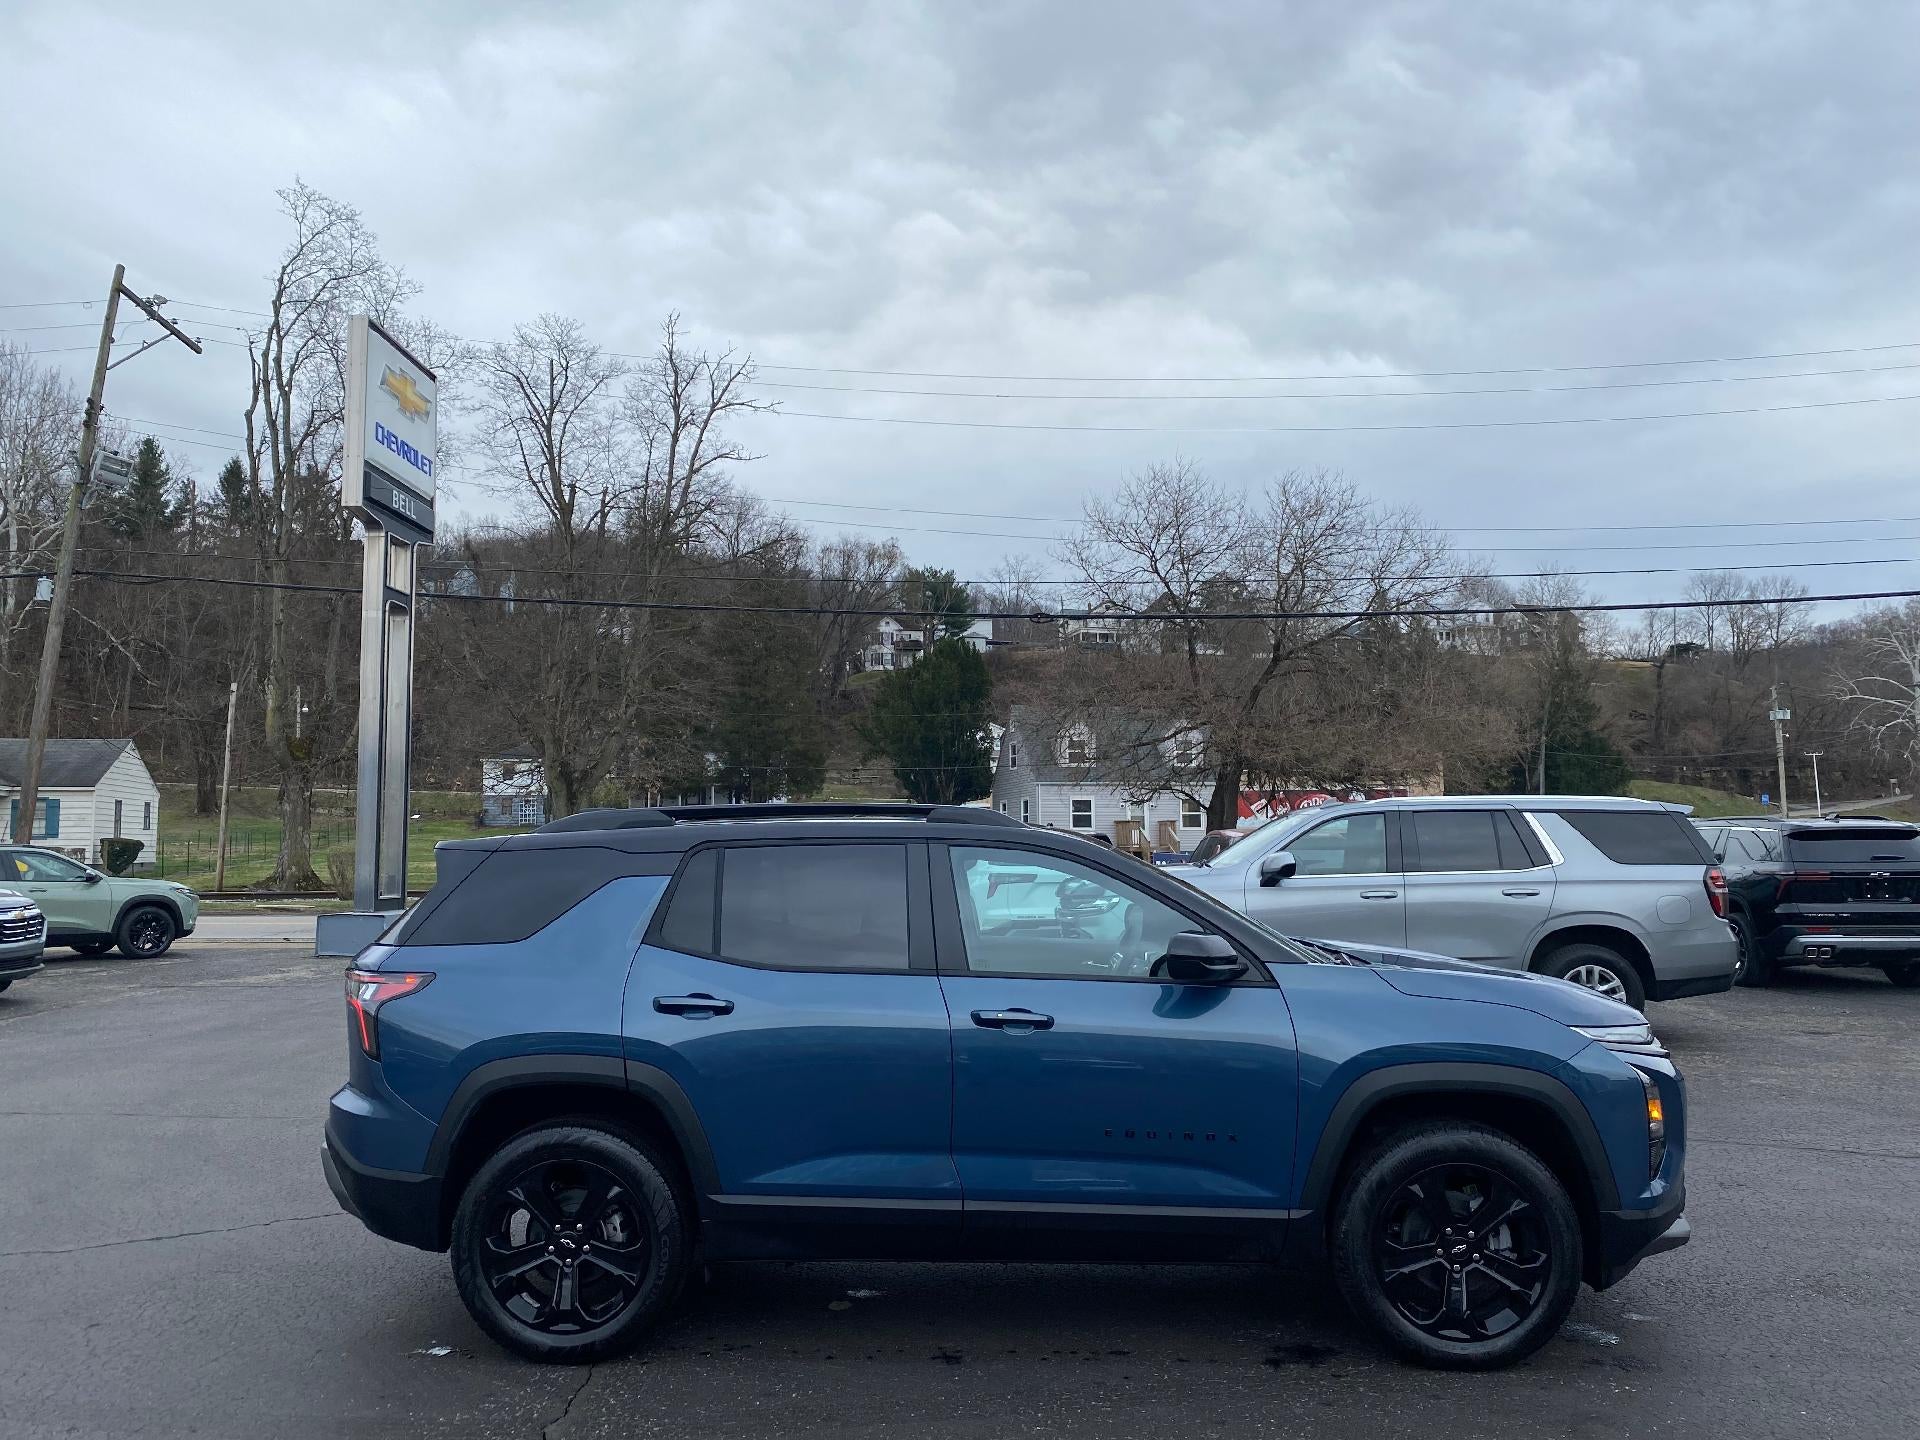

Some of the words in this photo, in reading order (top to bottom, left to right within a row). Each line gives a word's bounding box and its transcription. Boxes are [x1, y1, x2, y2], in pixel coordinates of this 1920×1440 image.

[375, 421, 433, 477] CHEVROLET
[392, 489, 417, 519] BELL
[1104, 1127, 1239, 1143] EQUINOX
